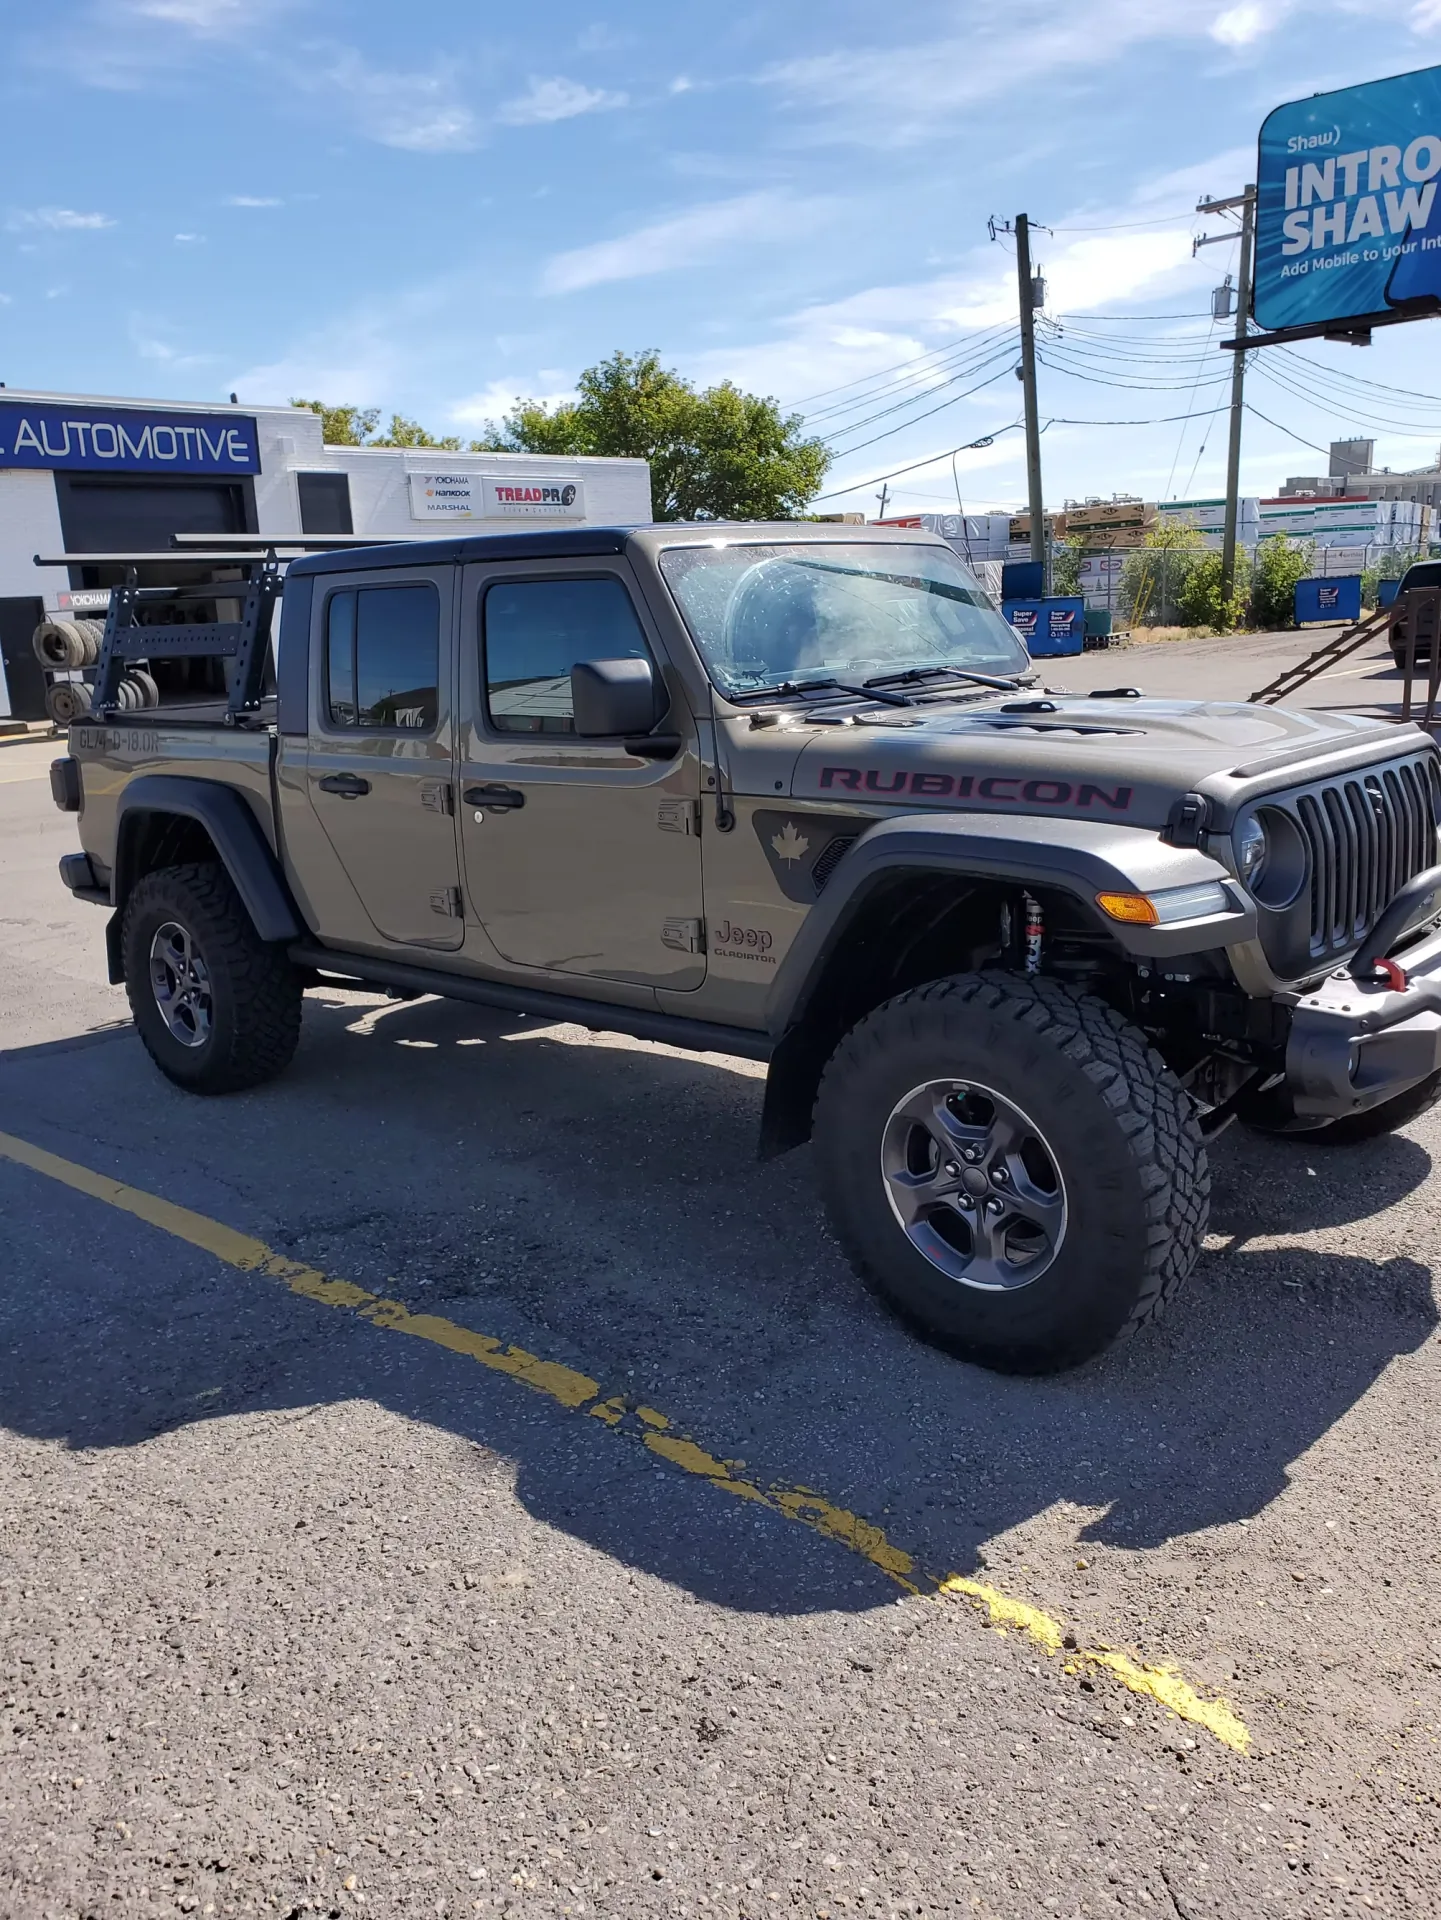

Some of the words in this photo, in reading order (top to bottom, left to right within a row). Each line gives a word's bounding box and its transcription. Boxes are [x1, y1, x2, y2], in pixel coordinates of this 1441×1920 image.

[1284, 135, 1441, 211] INTRO
[1281, 182, 1438, 256] SHAW
[1280, 260, 1309, 278] Add
[1312, 251, 1360, 272] Mobile
[1363, 246, 1379, 262] to
[1382, 241, 1418, 262] your
[13, 418, 250, 462] AUTOMOTIVE
[434, 476, 470, 485] YOKOHAMA
[819, 767, 1134, 810] RUBICON
[714, 948, 777, 964] GLADIATOR
[715, 920, 773, 952] Jeep
